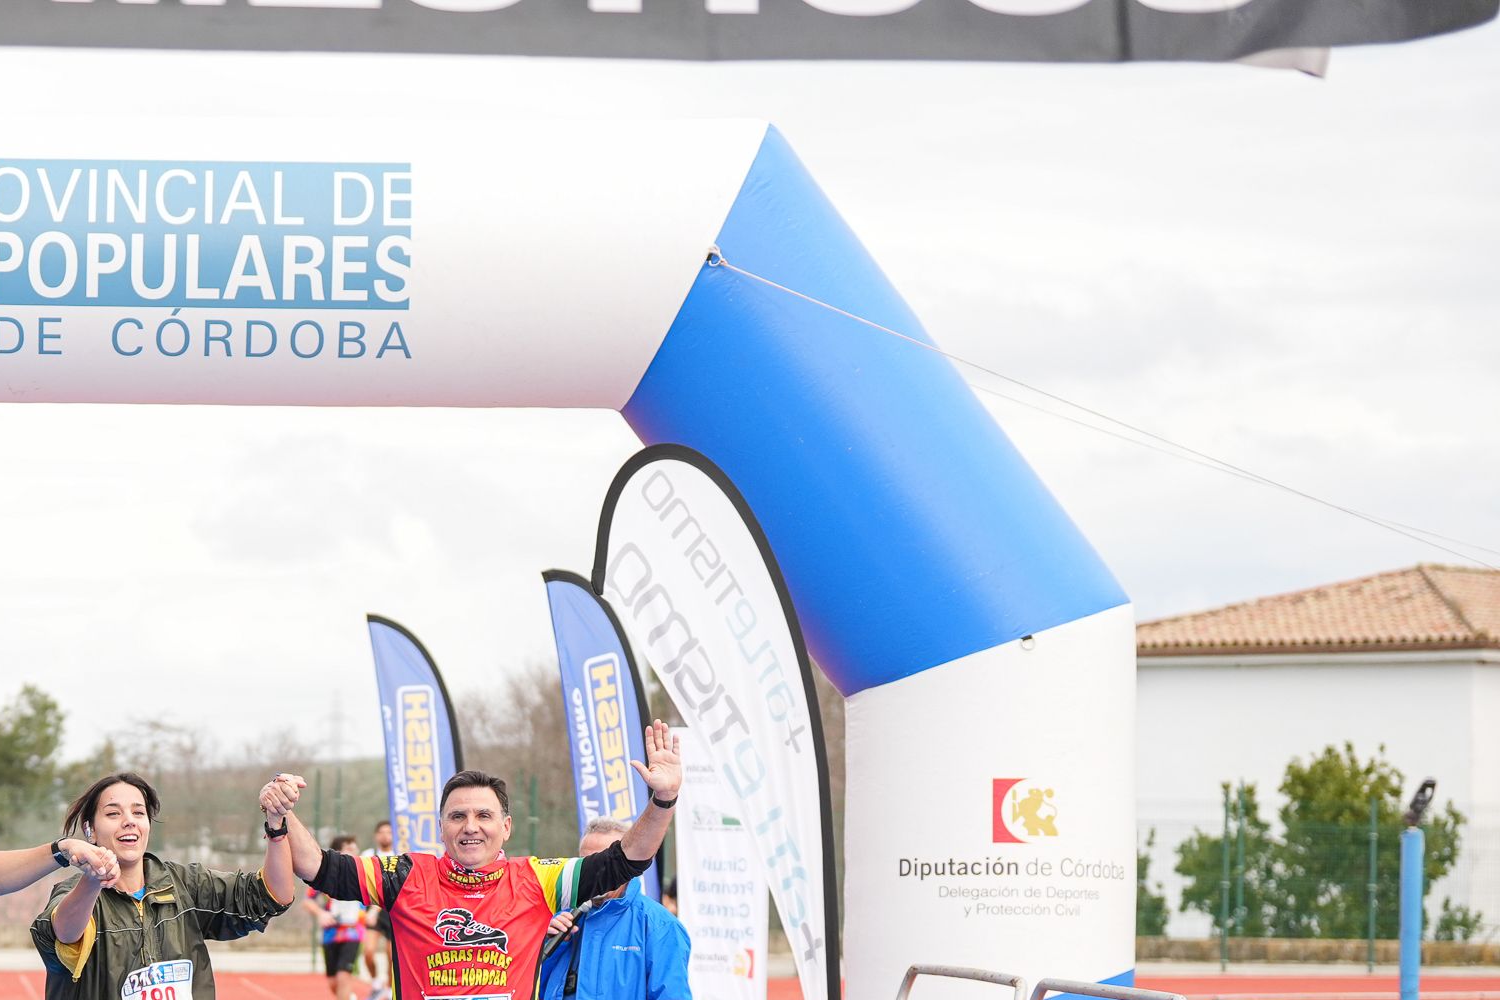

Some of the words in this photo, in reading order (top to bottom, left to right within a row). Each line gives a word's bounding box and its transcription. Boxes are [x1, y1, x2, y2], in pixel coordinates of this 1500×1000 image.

[333, 172, 411, 228] DE
[111, 309, 412, 360] CÓRDOBA
[899, 857, 1018, 880] Diputación
[1025, 857, 1052, 877] de
[1060, 857, 1125, 880] Córdoba
[938, 885, 1019, 901] Delegación
[1024, 886, 1041, 898] de
[1046, 887, 1100, 902] Deportes
[963, 905, 972, 918] y
[976, 902, 1050, 916] Protección
[1055, 903, 1081, 916] Civil
[448, 929, 460, 941] K
[427, 949, 473, 969] KABRAS
[477, 949, 512, 969] LOKAS
[429, 969, 457, 986] TRAIL
